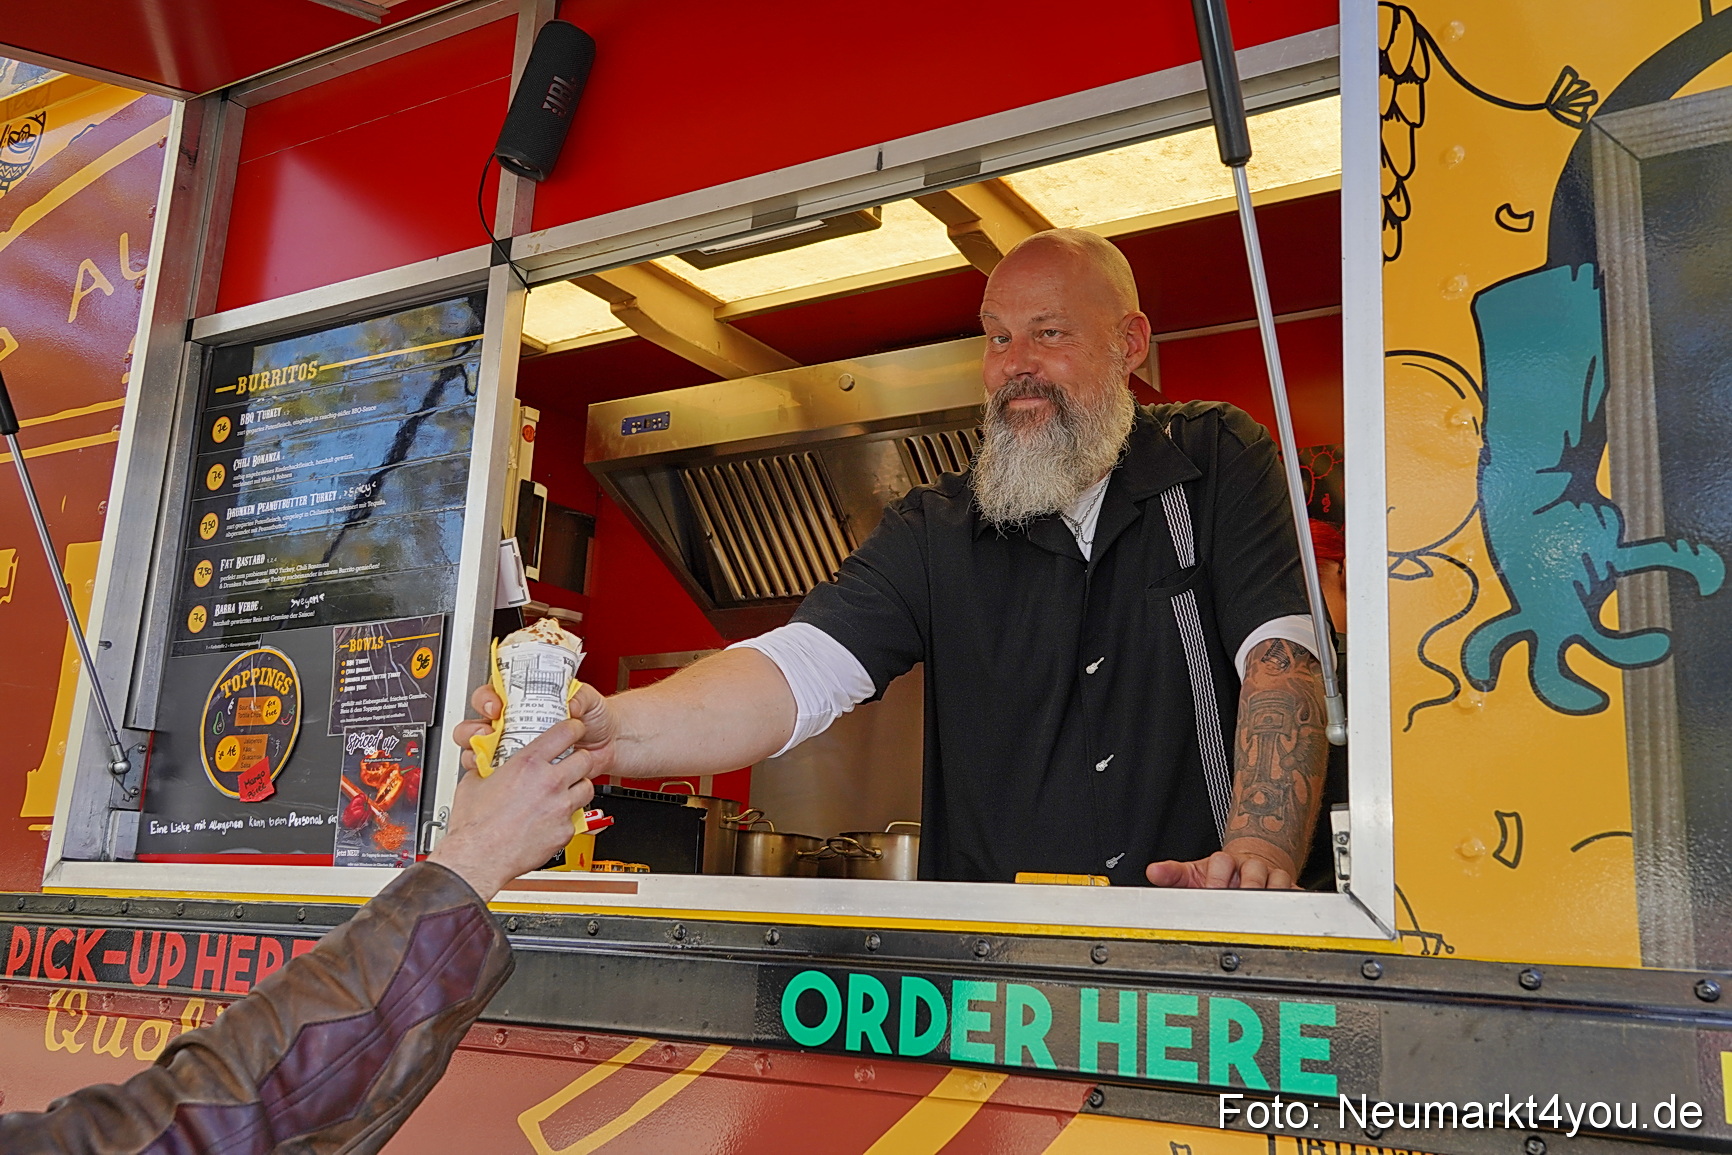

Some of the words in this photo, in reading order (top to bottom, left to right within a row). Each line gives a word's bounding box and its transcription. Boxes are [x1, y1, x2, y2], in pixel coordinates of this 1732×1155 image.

[546, 75, 576, 118] JBL
[236, 360, 318, 395] BURRITOS
[240, 411, 255, 426] BBQ
[256, 407, 283, 423] TURKEY
[233, 457, 250, 471] CHILI
[252, 451, 280, 468] BONANZA
[226, 504, 255, 520] DRUNKEN
[257, 494, 308, 515] PEANUTBUTTER
[310, 490, 337, 506] TURKEY
[201, 519, 216, 534] 7,50
[198, 566, 212, 578] 7,50
[220, 557, 235, 572] FAT
[236, 553, 266, 569] BASTARD
[193, 613, 205, 623] 7€
[214, 603, 236, 617] BARRA
[238, 600, 260, 615] VERDE
[349, 635, 384, 652] BOWLS
[220, 667, 294, 699] TOPPINGS
[218, 750, 224, 760] je
[227, 745, 237, 757] 1€
[244, 771, 265, 789] Mango
[150, 820, 168, 834] Eine
[170, 821, 191, 834] Liste
[194, 819, 206, 830] mit
[268, 816, 287, 827] beim
[287, 811, 324, 827] Personal
[5, 925, 187, 989] PICK-UP
[780, 970, 1057, 1070] ORDER
[1079, 987, 1338, 1097] HERE
